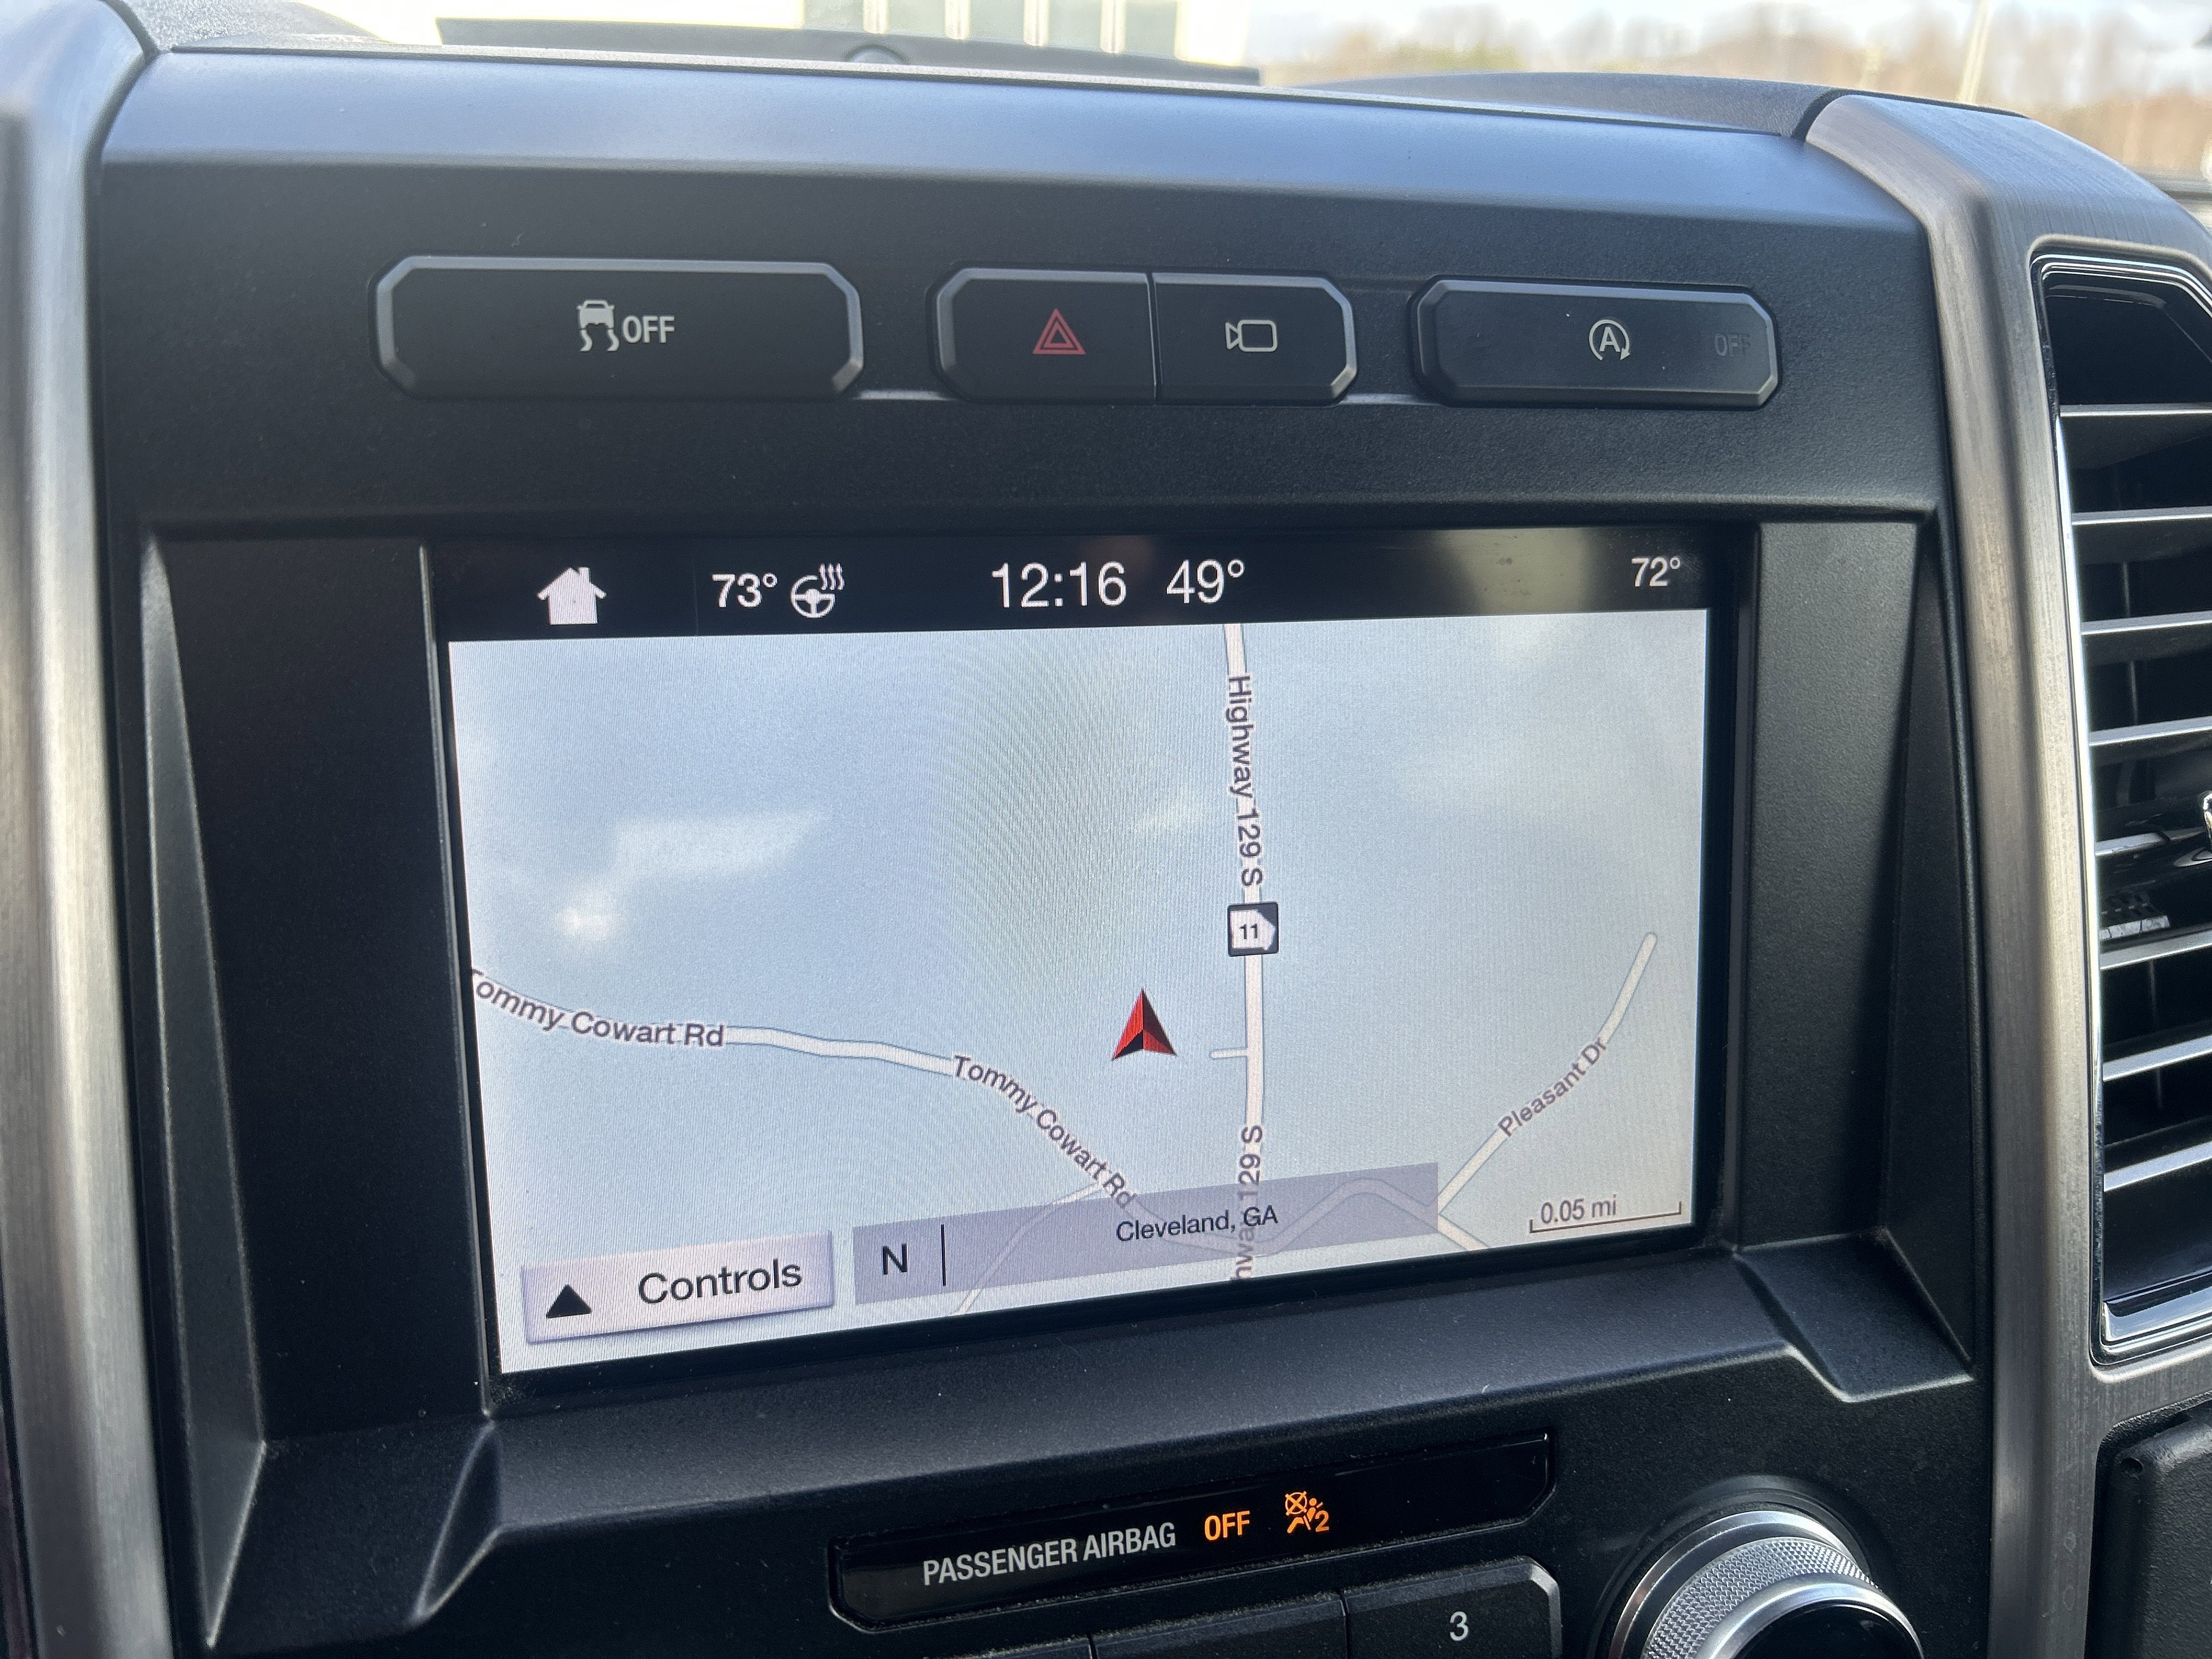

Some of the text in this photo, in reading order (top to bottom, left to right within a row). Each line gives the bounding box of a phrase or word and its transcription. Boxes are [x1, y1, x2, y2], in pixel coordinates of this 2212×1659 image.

[622, 315, 675, 343] OFF
[1714, 333, 1751, 357] OFF
[712, 572, 778, 607] 73°
[991, 561, 1126, 608] 12:16
[1165, 559, 1245, 605] 49°
[1632, 556, 1680, 587] 72°
[1226, 676, 1263, 886] Highway 129 S
[1239, 924, 1259, 940] 11
[472, 968, 725, 1047] ommy Cowart Rd
[1498, 1037, 1607, 1137] Pleasant Dr
[954, 1055, 1137, 1208] Tommy Cowart Rd
[1242, 1125, 1263, 1144] S
[1238, 1154, 1261, 1201] 129
[1116, 1205, 1278, 1242] Cleveland, GA
[1541, 1194, 1616, 1224] 0.05 mi
[882, 1243, 908, 1276] N
[638, 1258, 803, 1305] Controls
[923, 1510, 1250, 1585] PASSENGER AIRBAG OFF
[1448, 1611, 1469, 1641] 3
